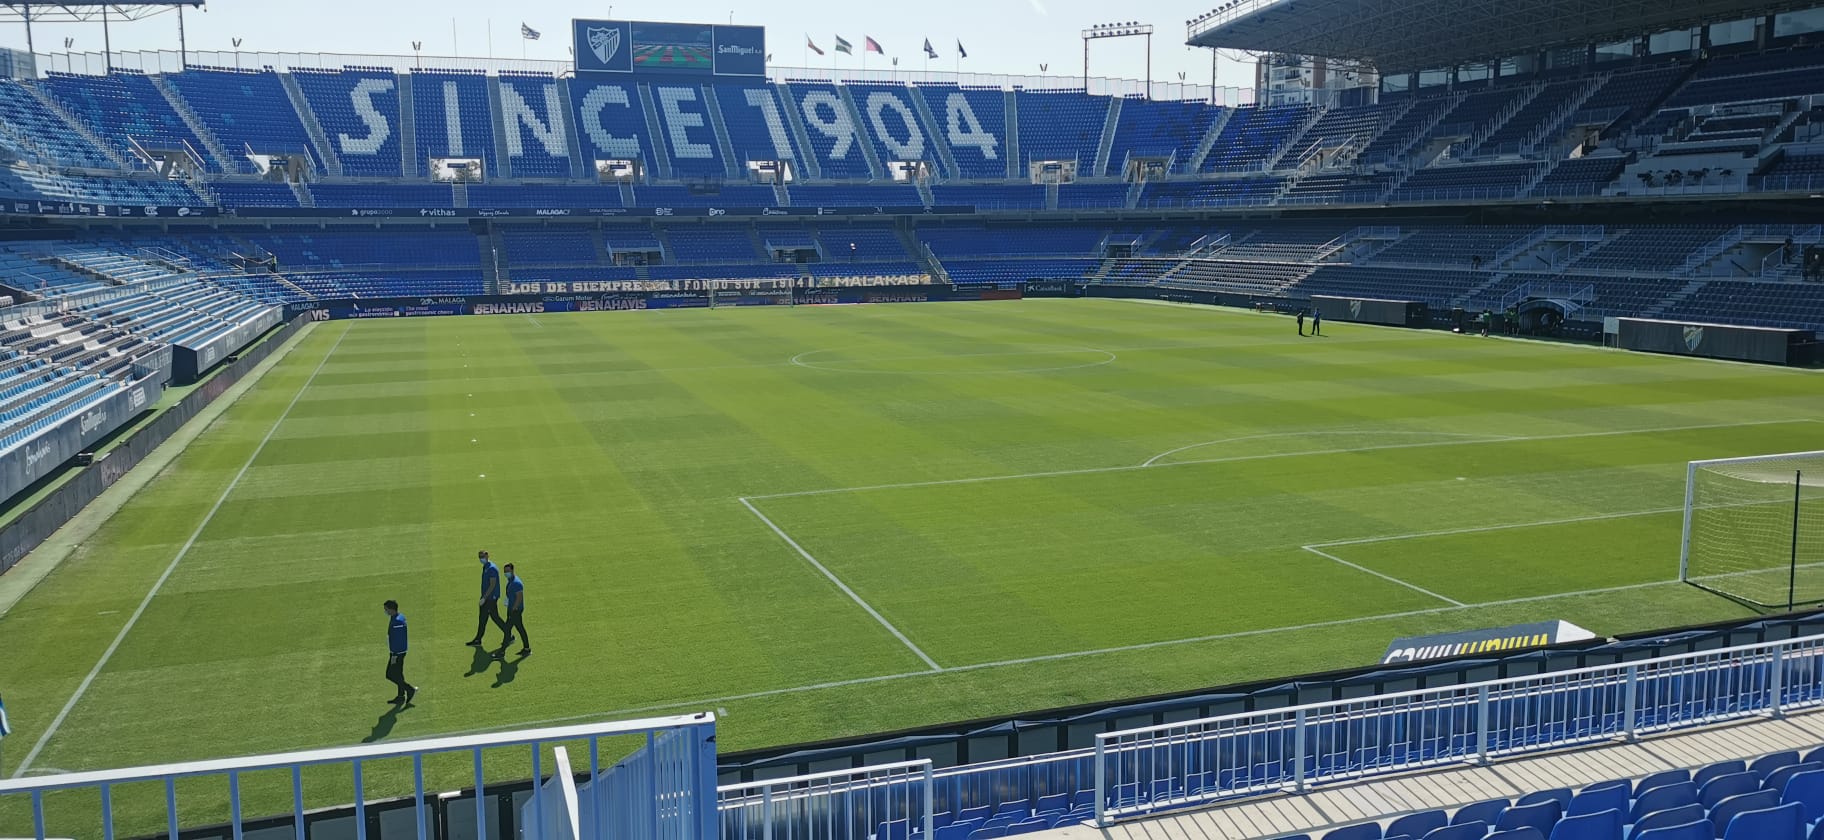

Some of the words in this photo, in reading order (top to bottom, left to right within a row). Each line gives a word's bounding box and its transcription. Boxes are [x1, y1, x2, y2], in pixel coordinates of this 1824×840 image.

[339, 78, 713, 158] SINCE
[743, 88, 999, 160] 1904
[429, 208, 456, 216] vithas
[510, 282, 541, 294] LOS
[547, 282, 568, 293] DE
[573, 280, 642, 292] SIEMPRE
[835, 275, 920, 287] MALAKAS
[473, 302, 545, 314] BENAHAVIS
[309, 309, 330, 321] VIS
